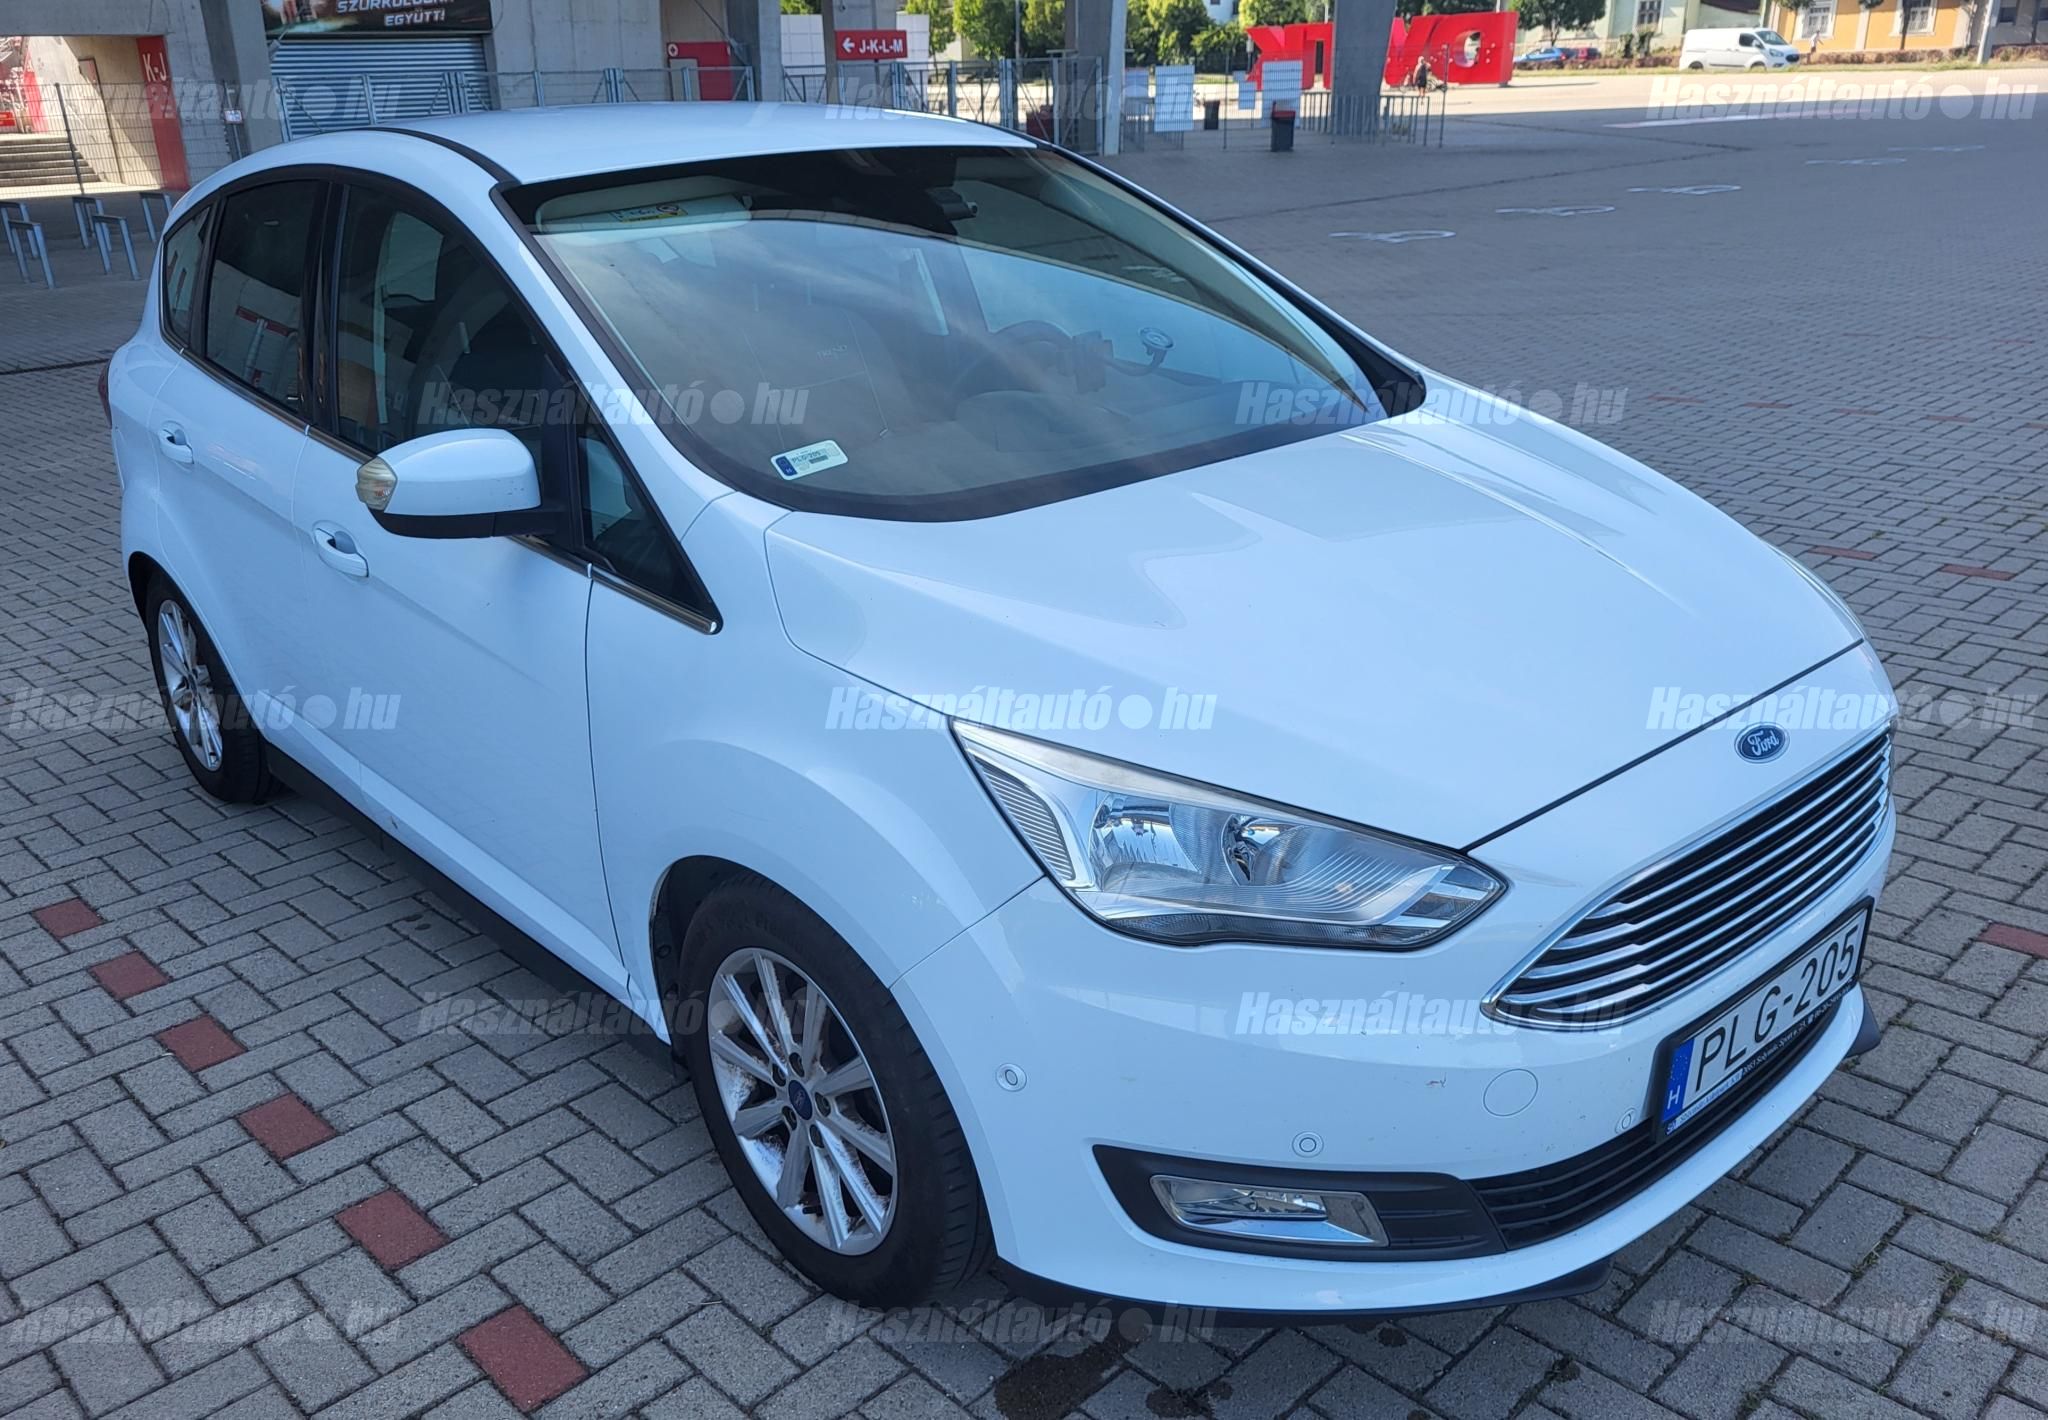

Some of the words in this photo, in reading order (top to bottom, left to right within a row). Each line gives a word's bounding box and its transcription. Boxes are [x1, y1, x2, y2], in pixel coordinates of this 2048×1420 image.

[336, 0, 455, 13] SZURKOL
[384, 7, 446, 26] EGYÜTT!
[1747, 730, 1780, 756] Ford
[1696, 925, 1860, 1092] PLG-205
[1667, 1085, 1681, 1110] H
